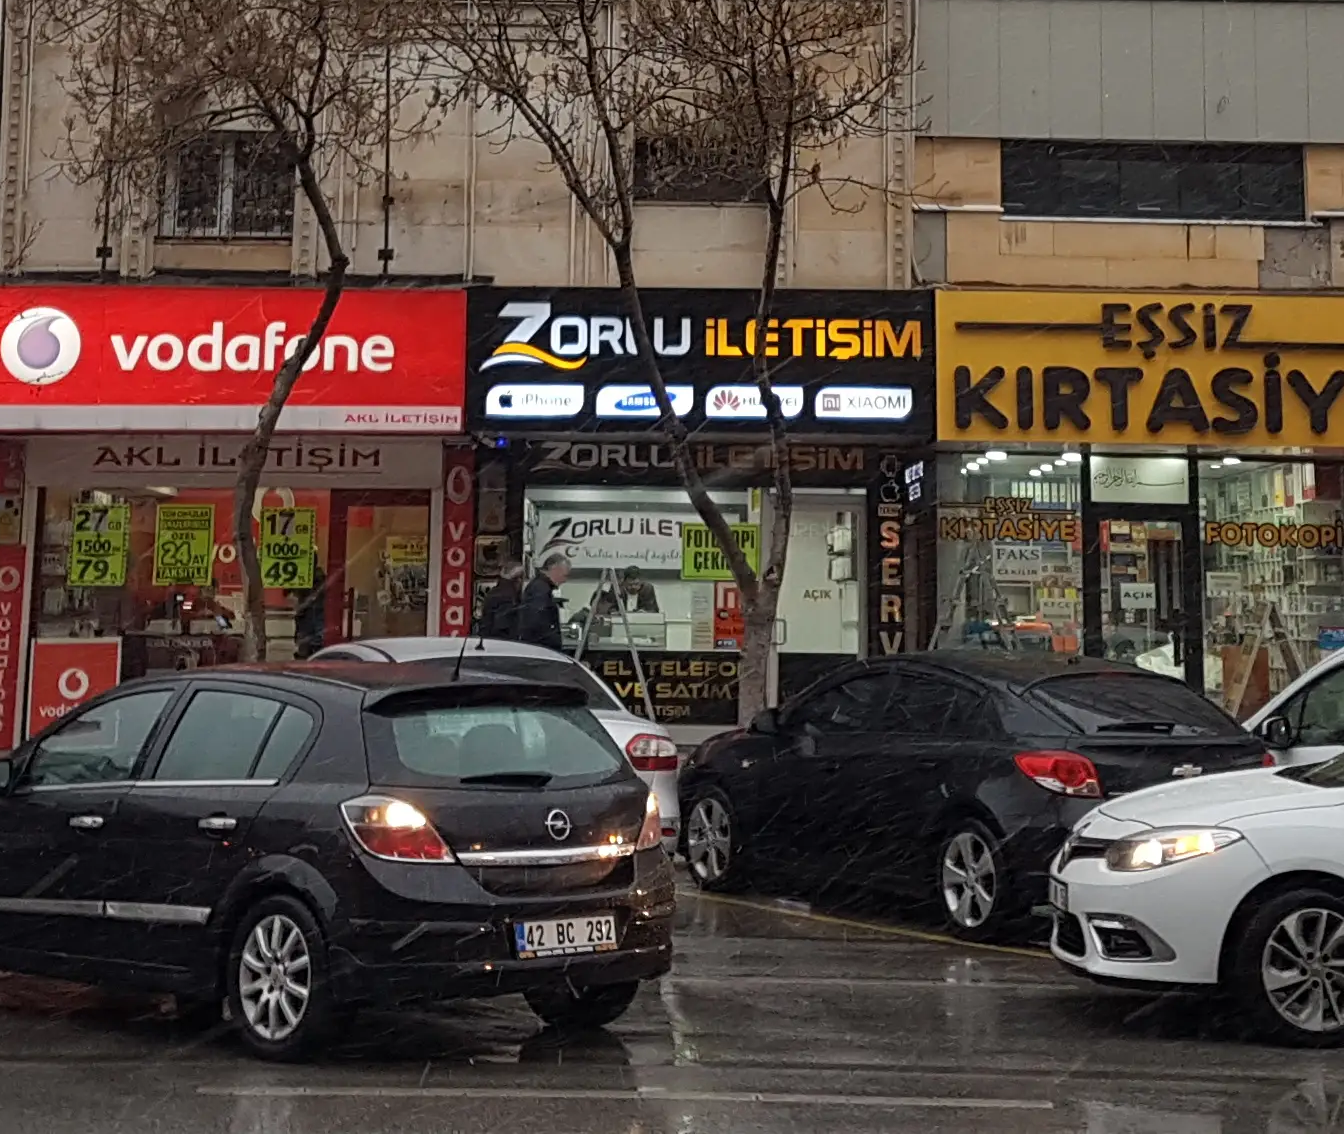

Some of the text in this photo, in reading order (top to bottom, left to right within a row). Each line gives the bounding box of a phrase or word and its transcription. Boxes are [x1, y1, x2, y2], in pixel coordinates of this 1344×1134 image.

[520, 392, 572, 408] iPhone
[742, 397, 798, 407] HUEI
[846, 394, 907, 410] XIAOMI
[344, 413, 379, 423] AKL
[92, 440, 382, 472] AKL İLTİŞİM
[76, 509, 109, 532] 27
[266, 511, 295, 535] 17
[548, 516, 634, 539] ZORLU
[1205, 518, 1344, 549] FOTOKOPİ
[76, 539, 112, 553] 1500
[161, 540, 191, 566] 24
[265, 542, 299, 556] 1000
[996, 548, 1041, 561] FAKS
[76, 559, 110, 580] 79
[264, 561, 299, 583] 49
[444, 521, 467, 637] voda
[803, 589, 832, 602] AÇIK
[1123, 590, 1154, 602] AÇIK
[603, 660, 739, 677] EL TELEFO
[526, 919, 613, 947] 42 BC 292
